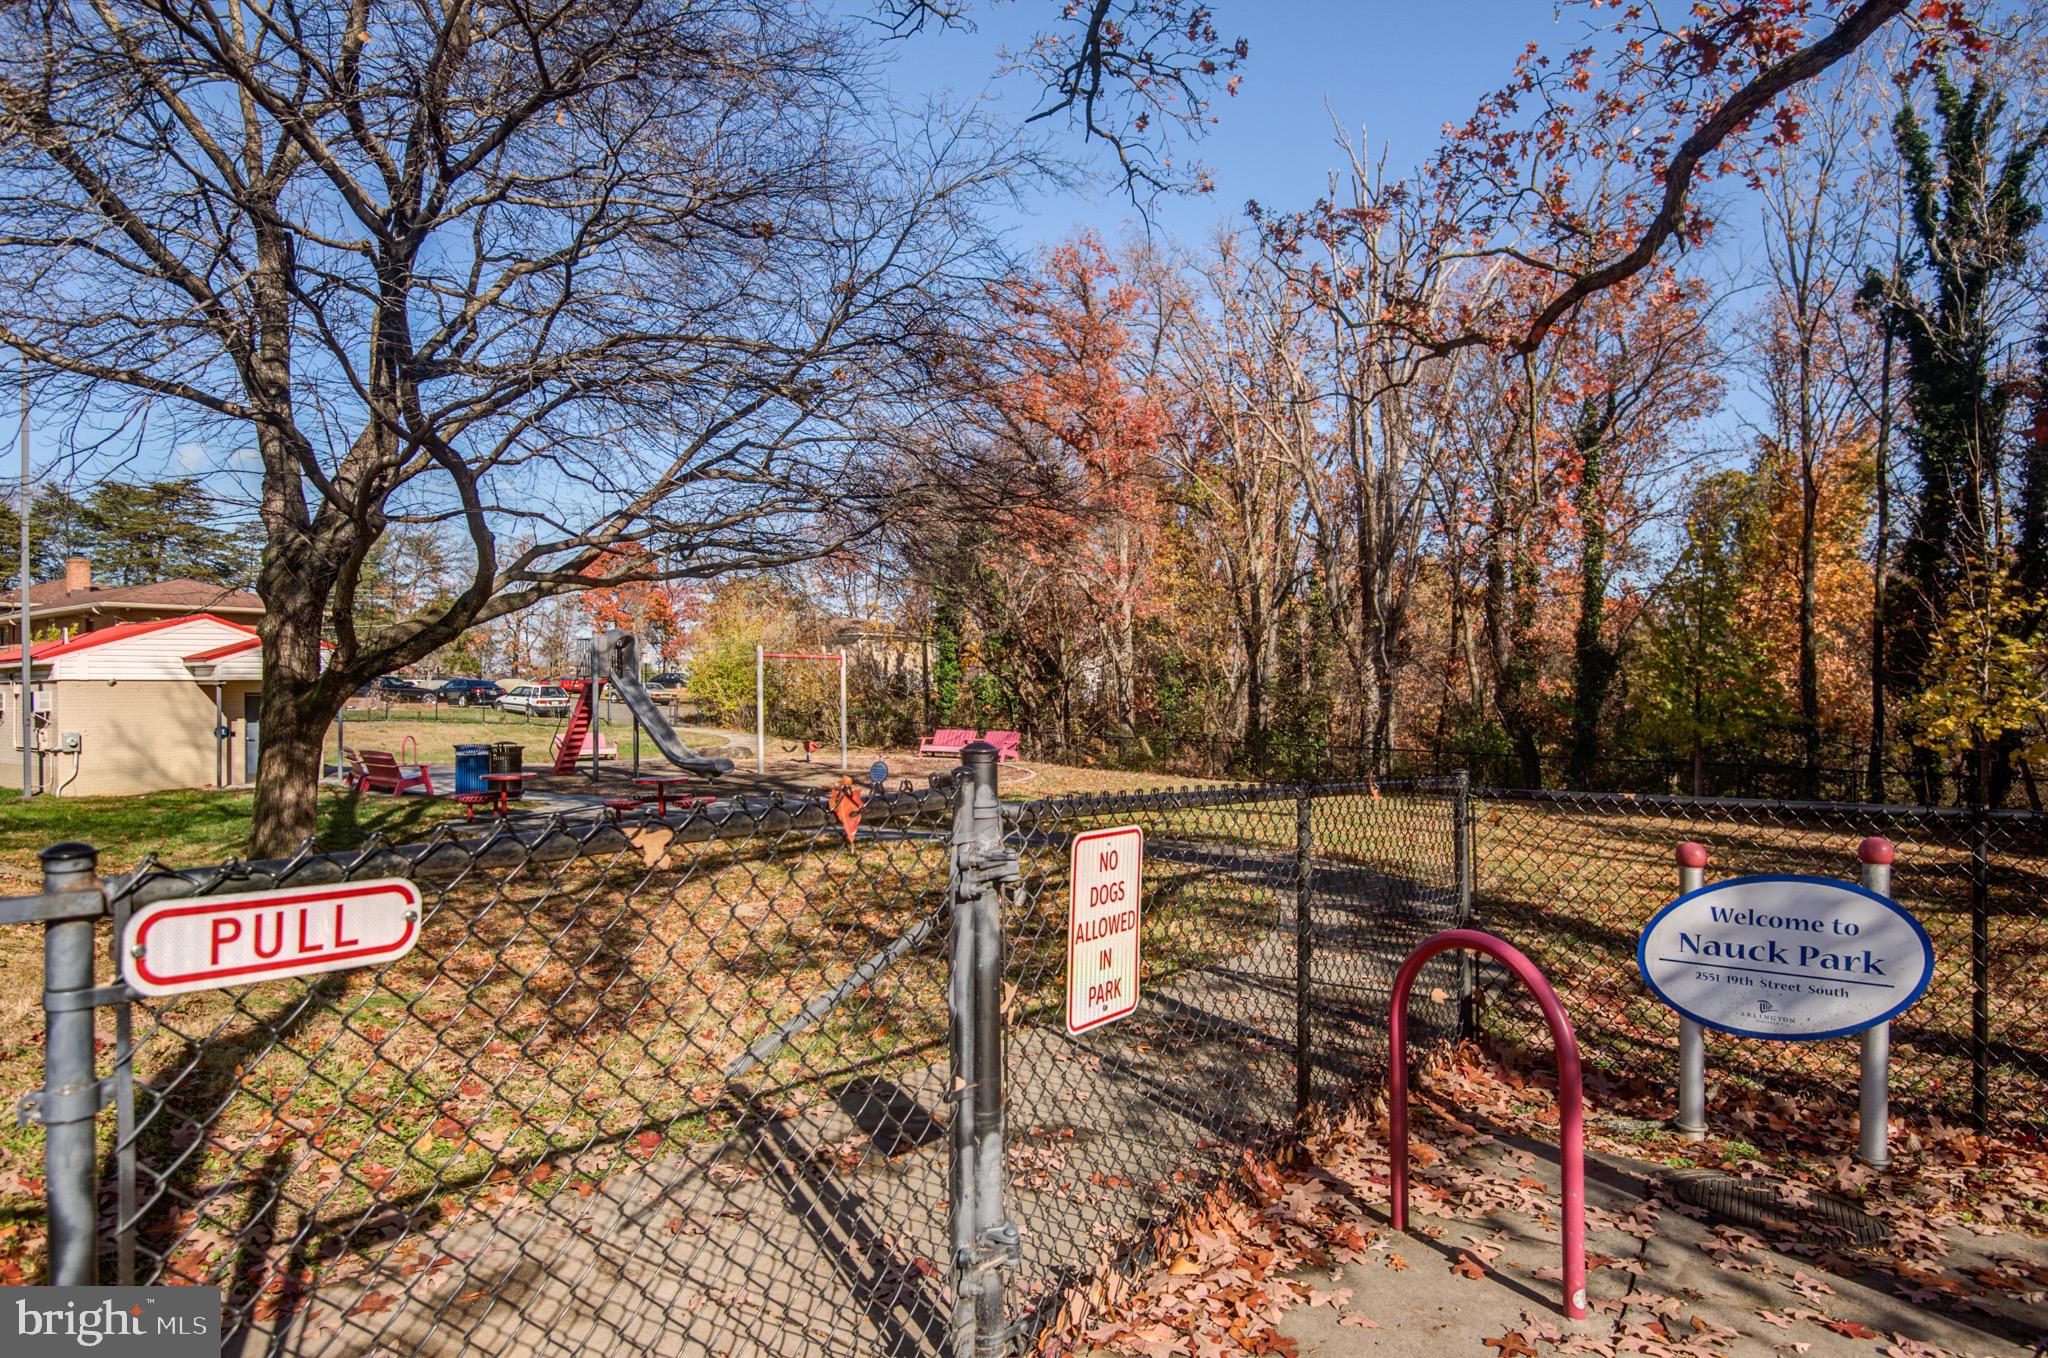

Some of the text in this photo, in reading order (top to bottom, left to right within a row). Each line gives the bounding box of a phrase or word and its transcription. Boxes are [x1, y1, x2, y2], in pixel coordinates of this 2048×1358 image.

[1099, 849, 1118, 873] NO
[1090, 880, 1125, 908] DOGS
[210, 904, 359, 966] PULL
[1075, 910, 1136, 945] ALLOWED
[1710, 906, 1860, 936] Welcome to
[1099, 948, 1112, 972] IN
[1679, 932, 1886, 976] Nauck Park
[1088, 977, 1122, 1008] PARK
[1695, 971, 1849, 998] 2551 19th Street South
[1740, 1011, 1796, 1024] ARLINGTON
